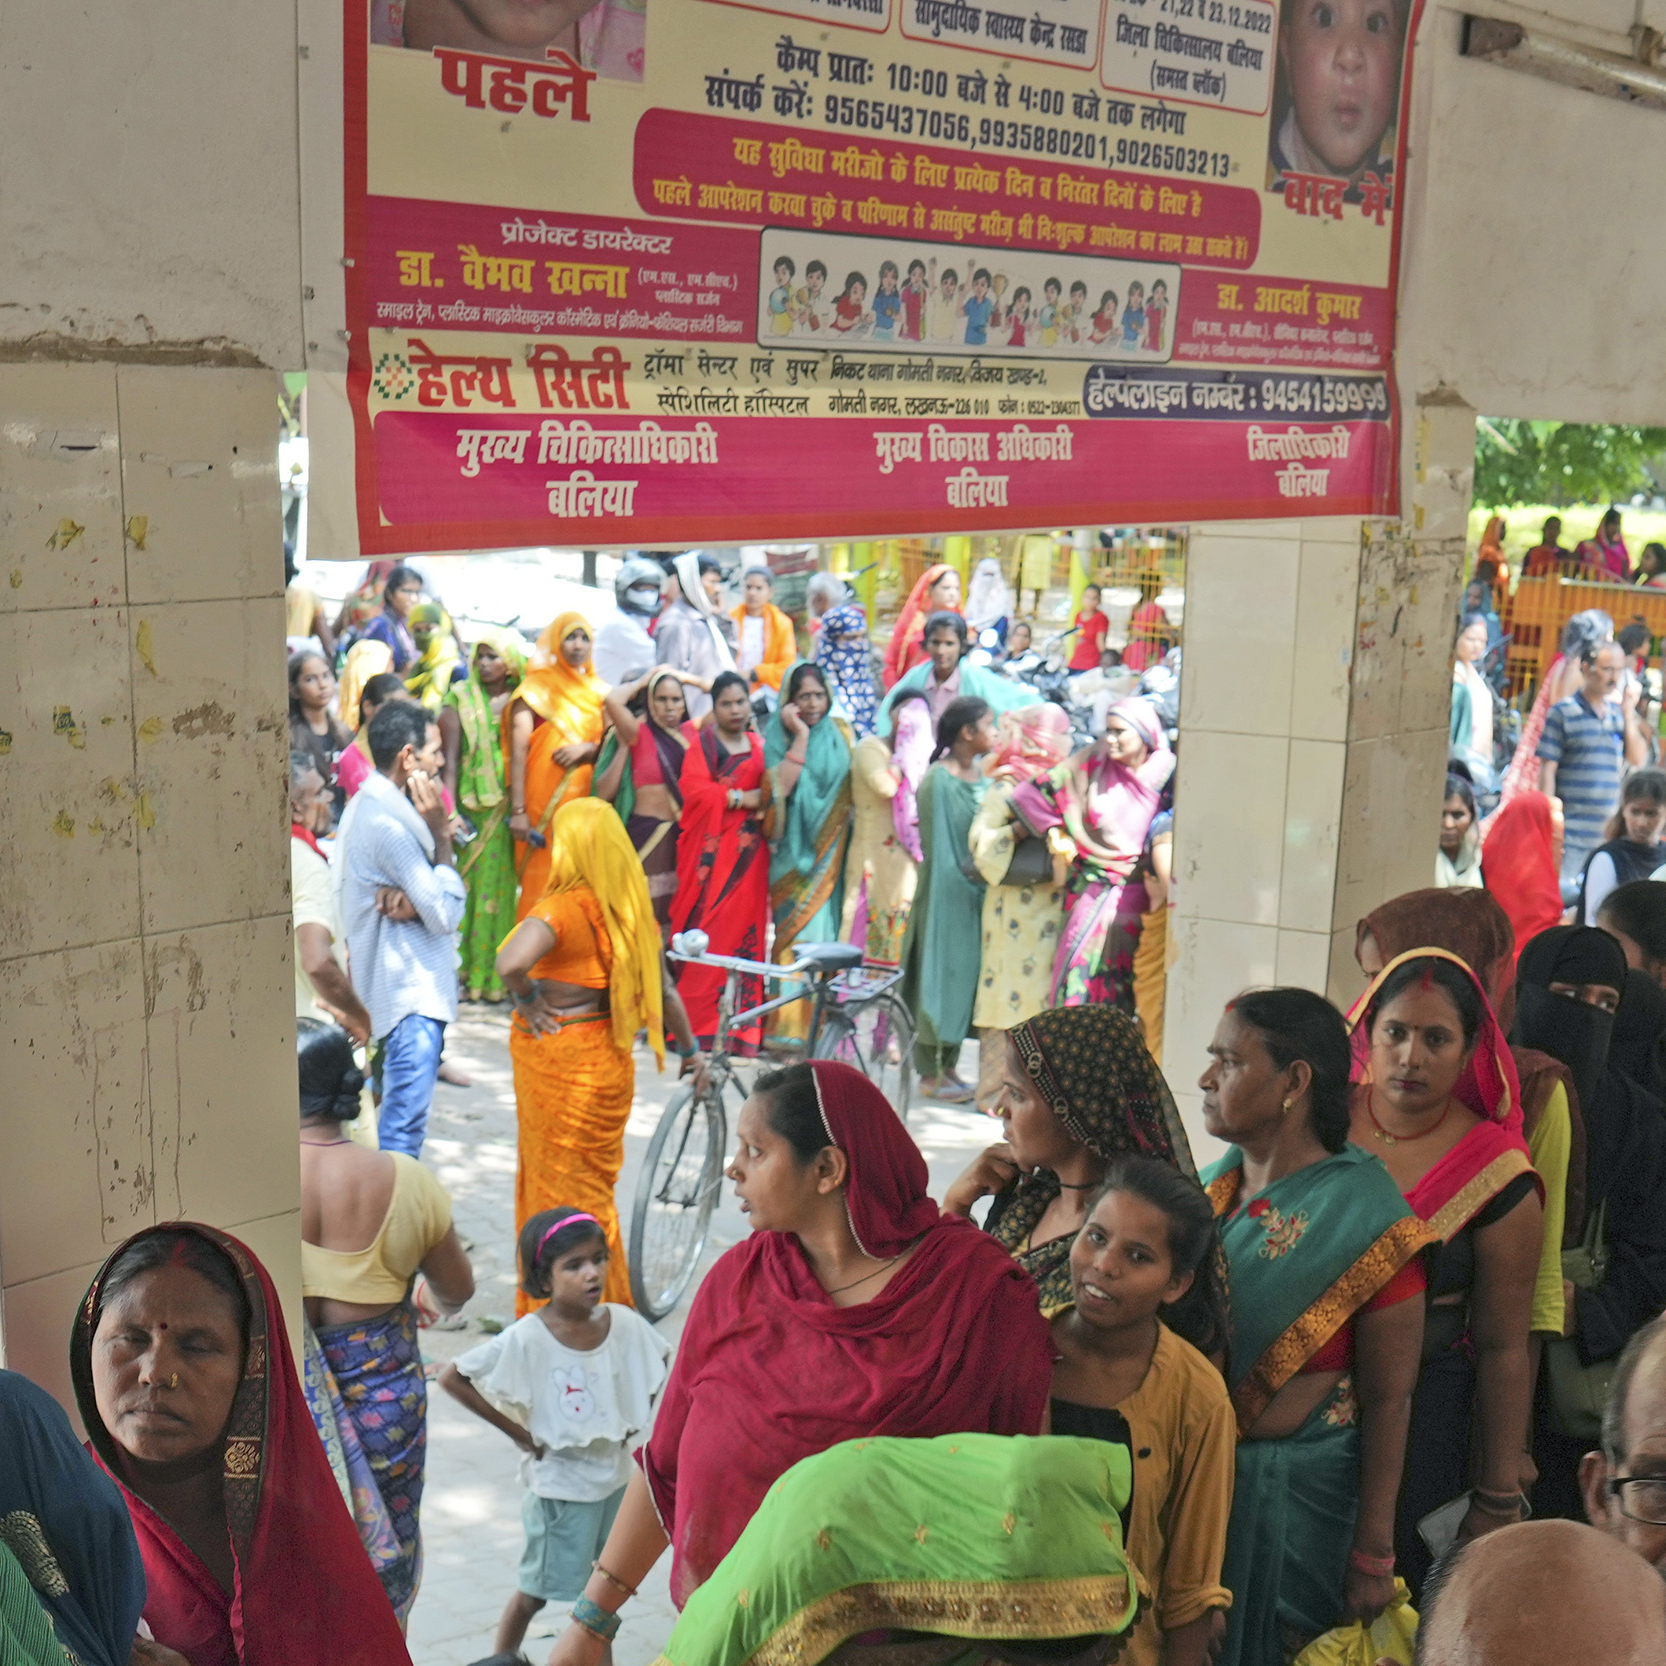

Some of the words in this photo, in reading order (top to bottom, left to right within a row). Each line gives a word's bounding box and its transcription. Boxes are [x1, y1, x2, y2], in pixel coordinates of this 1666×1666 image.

[1209, 1, 1271, 34] 23.12.2022
[1116, 13, 1151, 48] जिला
[1227, 39, 1263, 71] बलिया
[433, 44, 597, 123] पहले
[704, 67, 765, 112] संपर्क
[775, 34, 821, 78] कैम्प
[887, 62, 948, 98] 10:00
[956, 69, 988, 105] बजे
[994, 73, 1012, 109] से
[1019, 84, 1065, 116] 4:00
[1071, 88, 1101, 122] बजे
[1107, 98, 1135, 127] तक
[1141, 100, 1187, 136] लगेगा
[733, 136, 763, 166] यह
[768, 137, 826, 178] सुविधा
[890, 152, 910, 184] के
[913, 155, 950, 188] लिए
[953, 162, 1001, 194] प्रत्येक
[1005, 166, 1035, 198] दिन
[1040, 176, 1053, 201] व
[1057, 173, 1100, 206] निरंतर
[1139, 183, 1156, 212] के
[1159, 186, 1189, 216] लिए
[1281, 170, 1350, 221] बाद
[1359, 171, 1394, 226] में
[653, 174, 692, 207] पहले
[768, 190, 807, 218] करवा
[811, 191, 837, 228] चुके
[841, 199, 853, 222] व
[857, 196, 909, 228] परिणाम
[913, 201, 926, 230] से
[500, 216, 579, 247] प्रोजेक्ट
[582, 225, 674, 255] डायरेक्टर
[395, 250, 444, 288] डा.
[457, 243, 536, 294] वैभव
[544, 260, 631, 299] खन्ना
[1217, 283, 1244, 312] डा.
[1254, 283, 1311, 316] आदर्श
[1315, 291, 1362, 326] कुमार
[406, 338, 517, 410] हेल्थ
[526, 342, 631, 411] सिटी
[644, 347, 684, 380] ट्रॉमा
[750, 351, 774, 384] एवं
[786, 358, 820, 386] सुपर
[830, 355, 866, 380] निकट
[896, 357, 935, 383] गोमती
[1087, 367, 1188, 414] हेल्पलाइन
[828, 387, 866, 415] गोमती
[456, 428, 532, 478] मुख्य
[537, 419, 719, 466] चिकित्साधिकारी
[873, 431, 923, 475] मुख्य
[927, 422, 990, 463] विकास
[996, 423, 1074, 462] अधिकारी
[1246, 423, 1351, 462] जिलाधिकारी
[546, 469, 638, 518] बलिया
[945, 465, 1009, 509] बलिया
[1275, 461, 1330, 498] बलिया
